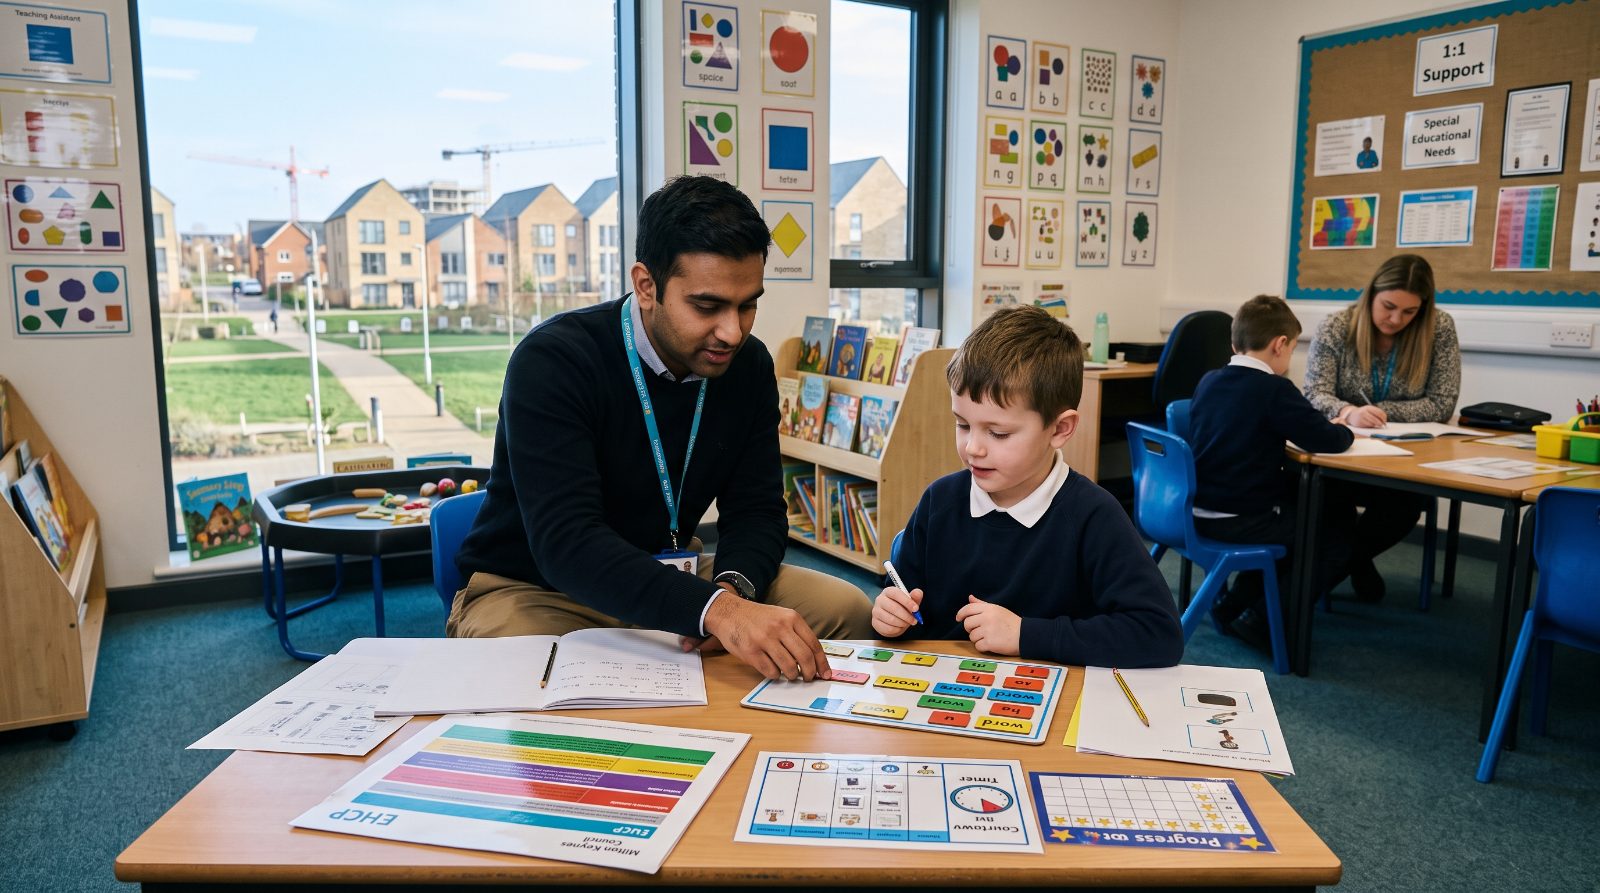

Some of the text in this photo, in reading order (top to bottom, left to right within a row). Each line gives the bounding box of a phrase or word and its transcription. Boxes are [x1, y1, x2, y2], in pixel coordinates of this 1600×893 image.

[15, 9, 81, 22] Teaching Assistant
[1443, 42, 1466, 59] 1:1
[1423, 61, 1485, 83] Support
[995, 90, 1017, 101] a a
[1039, 91, 1059, 106] b b
[1088, 101, 1106, 111] c c
[1137, 104, 1156, 117] d d
[1424, 115, 1460, 130] Special
[1412, 129, 1472, 145] Educational
[1424, 146, 1456, 158] Needs
[993, 169, 1014, 184] n g
[1037, 172, 1044, 185] p
[1084, 175, 1104, 186] m h
[882, 678, 919, 687] word
[995, 692, 1034, 700] word
[981, 719, 1023, 729] word
[328, 808, 399, 827] EHCP
[613, 825, 650, 836] EUCP
[583, 836, 623, 847] Council
[1135, 833, 1222, 847] Progress
[561, 840, 641, 857] Milton Keynes
